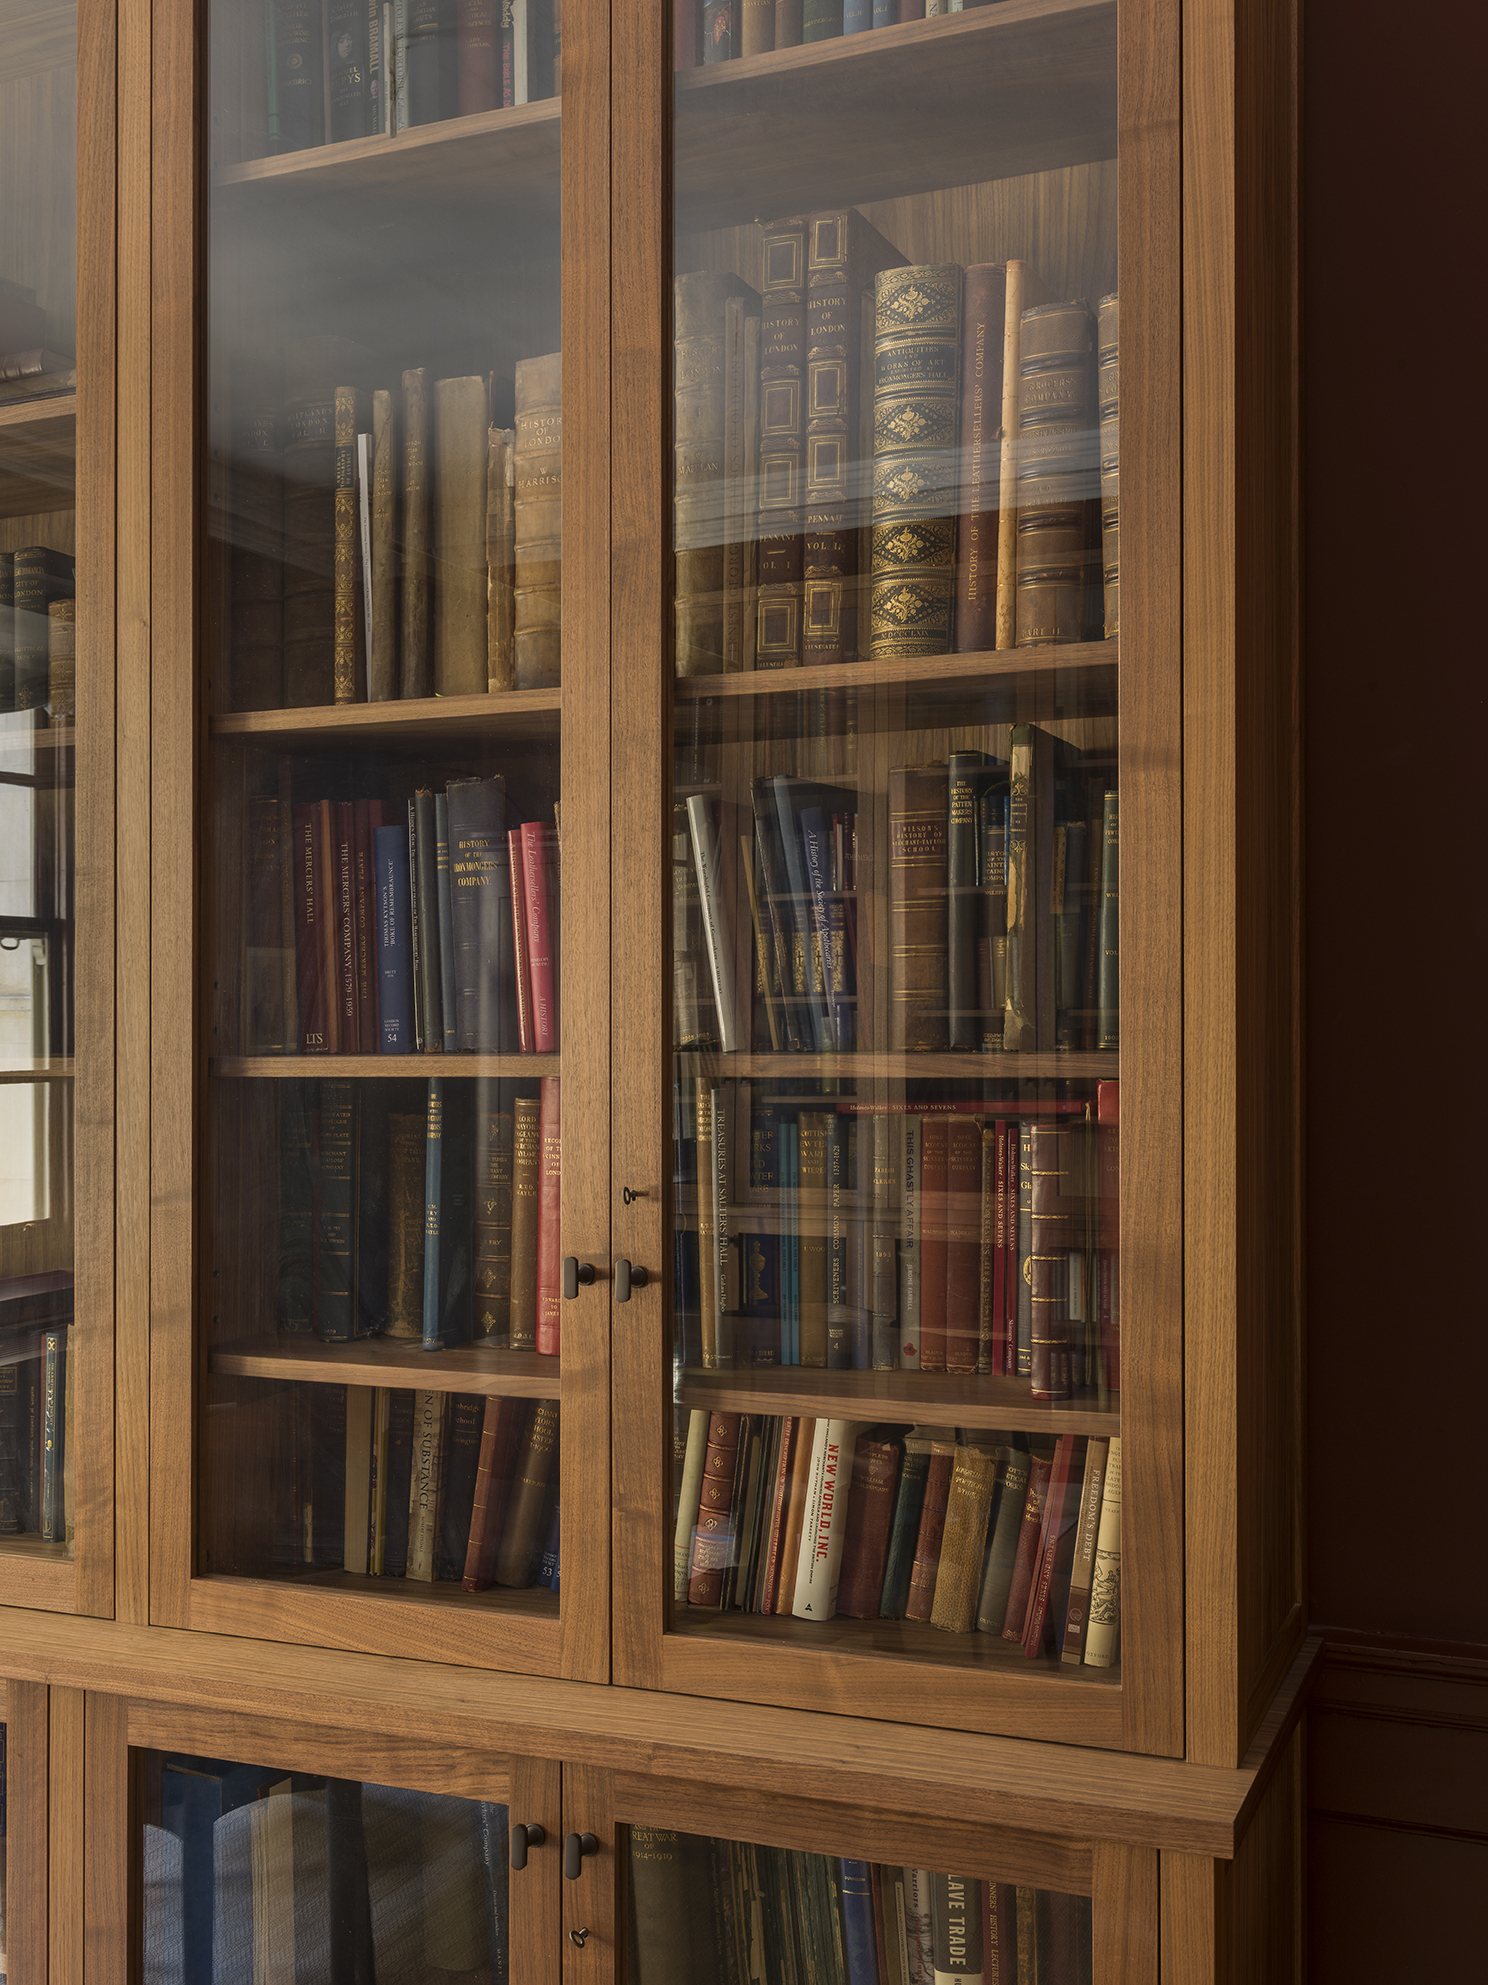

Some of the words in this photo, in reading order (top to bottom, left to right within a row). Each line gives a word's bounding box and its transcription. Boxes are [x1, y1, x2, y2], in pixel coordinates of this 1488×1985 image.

[330, 10, 358, 23] Tomalin
[332, 3, 353, 13] Claire
[369, 21, 379, 75] BRAMALL
[502, 42, 510, 60] THE
[502, 63, 510, 85] BIBLE
[503, 87, 511, 99] AS
[806, 295, 847, 310] HISTORY
[762, 318, 800, 330] HISTORY
[821, 311, 833, 320] OF
[774, 332, 786, 340] OF
[810, 324, 846, 336] LONDON
[680, 345, 723, 358] HISTORY
[764, 343, 798, 355] LONDON
[887, 346, 939, 358] ANTIQUITIES
[974, 322, 986, 377] COMPANY
[680, 365, 723, 380] LONDON
[881, 360, 909, 372] WORKS
[911, 359, 923, 367] OF
[1024, 389, 1072, 404] COMPANY
[731, 394, 741, 425] OLD
[536, 427, 548, 436] OF
[731, 432, 741, 448] OF
[971, 384, 983, 492] LEATHERSELLERS'
[539, 467, 548, 475] W
[970, 494, 981, 520] THE
[969, 526, 979, 541] OF
[728, 539, 740, 598] GEORGE
[968, 548, 979, 601] HISTORY
[727, 602, 739, 653] ERNEST
[304, 823, 312, 843] THE
[458, 840, 490, 849] HISTORY
[527, 831, 536, 847] The
[807, 829, 815, 838] A
[341, 841, 349, 863] THE
[808, 840, 819, 868] History
[304, 846, 313, 895] MERCERS'
[527, 849, 540, 904] Leathersellers'
[701, 863, 710, 894] Worshipful
[811, 869, 821, 877] of
[813, 877, 823, 888] the
[341, 865, 350, 916] MERCERS'
[815, 890, 826, 914] Society
[306, 898, 314, 924] HALL
[704, 894, 713, 920] Company
[818, 914, 827, 923] of
[531, 906, 541, 943] Company
[513, 887, 519, 897] OF
[518, 984, 527, 1026] COMPANY
[819, 923, 833, 970] Apothecaries
[344, 973, 353, 1017] 1579-1959
[540, 1002, 549, 1037] HISTORY
[305, 1033, 324, 1044] LTS
[717, 1108, 726, 1170] TREASURES
[906, 1130, 914, 1155] THIS
[800, 1150, 826, 1158] WARE
[718, 1172, 726, 1185] AT
[906, 1157, 914, 1207] GHASTLY
[832, 1183, 840, 1207] PAPER
[718, 1188, 727, 1235] SALTERS'
[832, 1215, 840, 1250] COMMON
[906, 1209, 914, 1248] AFFAIR
[719, 1236, 728, 1266] HALL
[832, 1257, 840, 1304] SCRIVENERS
[1006, 1345, 1014, 1370] Company
[423, 1409, 433, 1428] OF
[419, 1433, 433, 1510] SUBSTANCE
[825, 1443, 839, 1476] NEW
[818, 1480, 835, 1532] WORLD,
[1086, 1469, 1101, 1529] FREEDOM'S
[815, 1535, 829, 1563] INC.
[1046, 1535, 1056, 1562] SEVENS
[1083, 1533, 1093, 1562] DEBT
[542, 1567, 553, 1576] 53
[1043, 1563, 1051, 1580] AND
[1038, 1580, 1048, 1602] SIXES
[1086, 1651, 1110, 1659] OXFORD
[655, 1832, 677, 1842] WAR
[632, 1851, 673, 1862] 1914-1919
[947, 1873, 966, 1910] LAVE
[948, 1916, 966, 1966] TRADE
[990, 1914, 999, 1946] HISTORY
